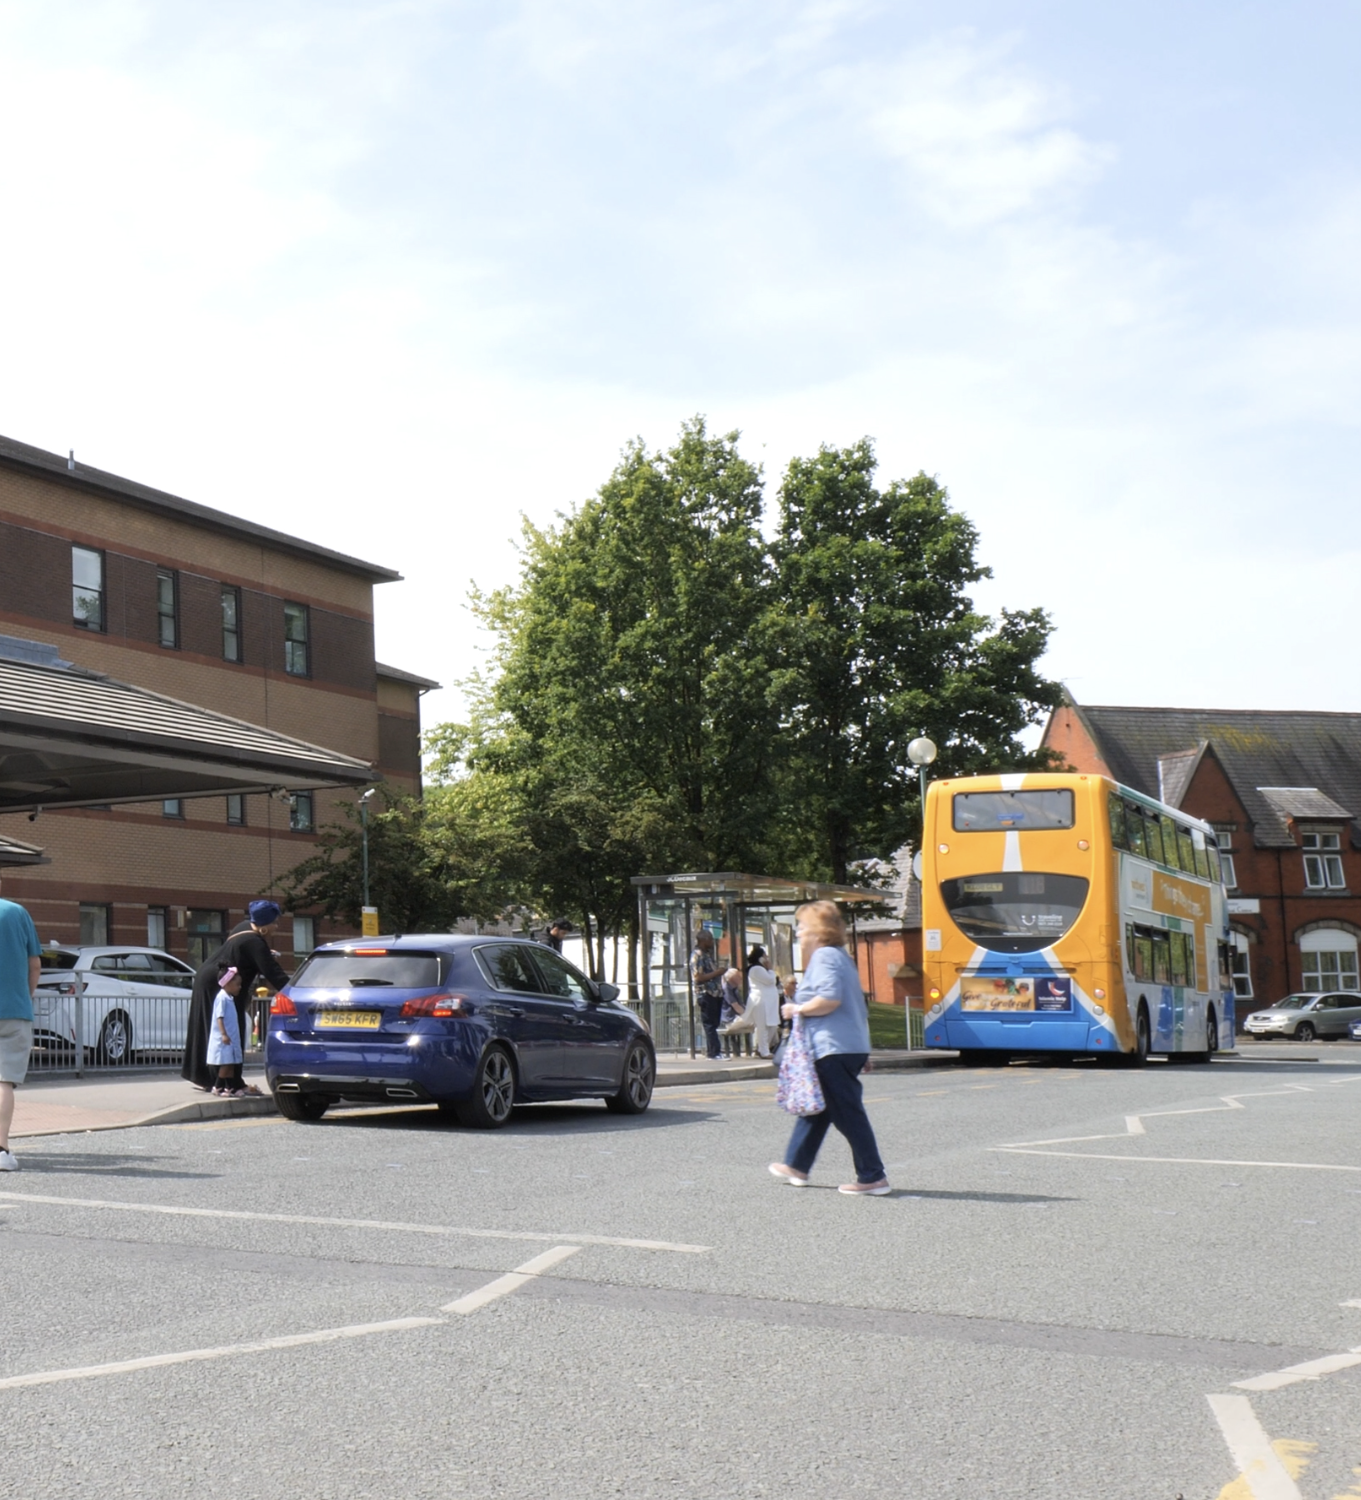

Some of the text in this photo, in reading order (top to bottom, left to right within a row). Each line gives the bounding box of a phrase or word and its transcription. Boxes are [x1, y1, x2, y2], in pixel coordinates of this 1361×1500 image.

[962, 990, 982, 1003] Give
[990, 997, 1032, 1011] Grateful
[354, 1013, 378, 1025] KFR
